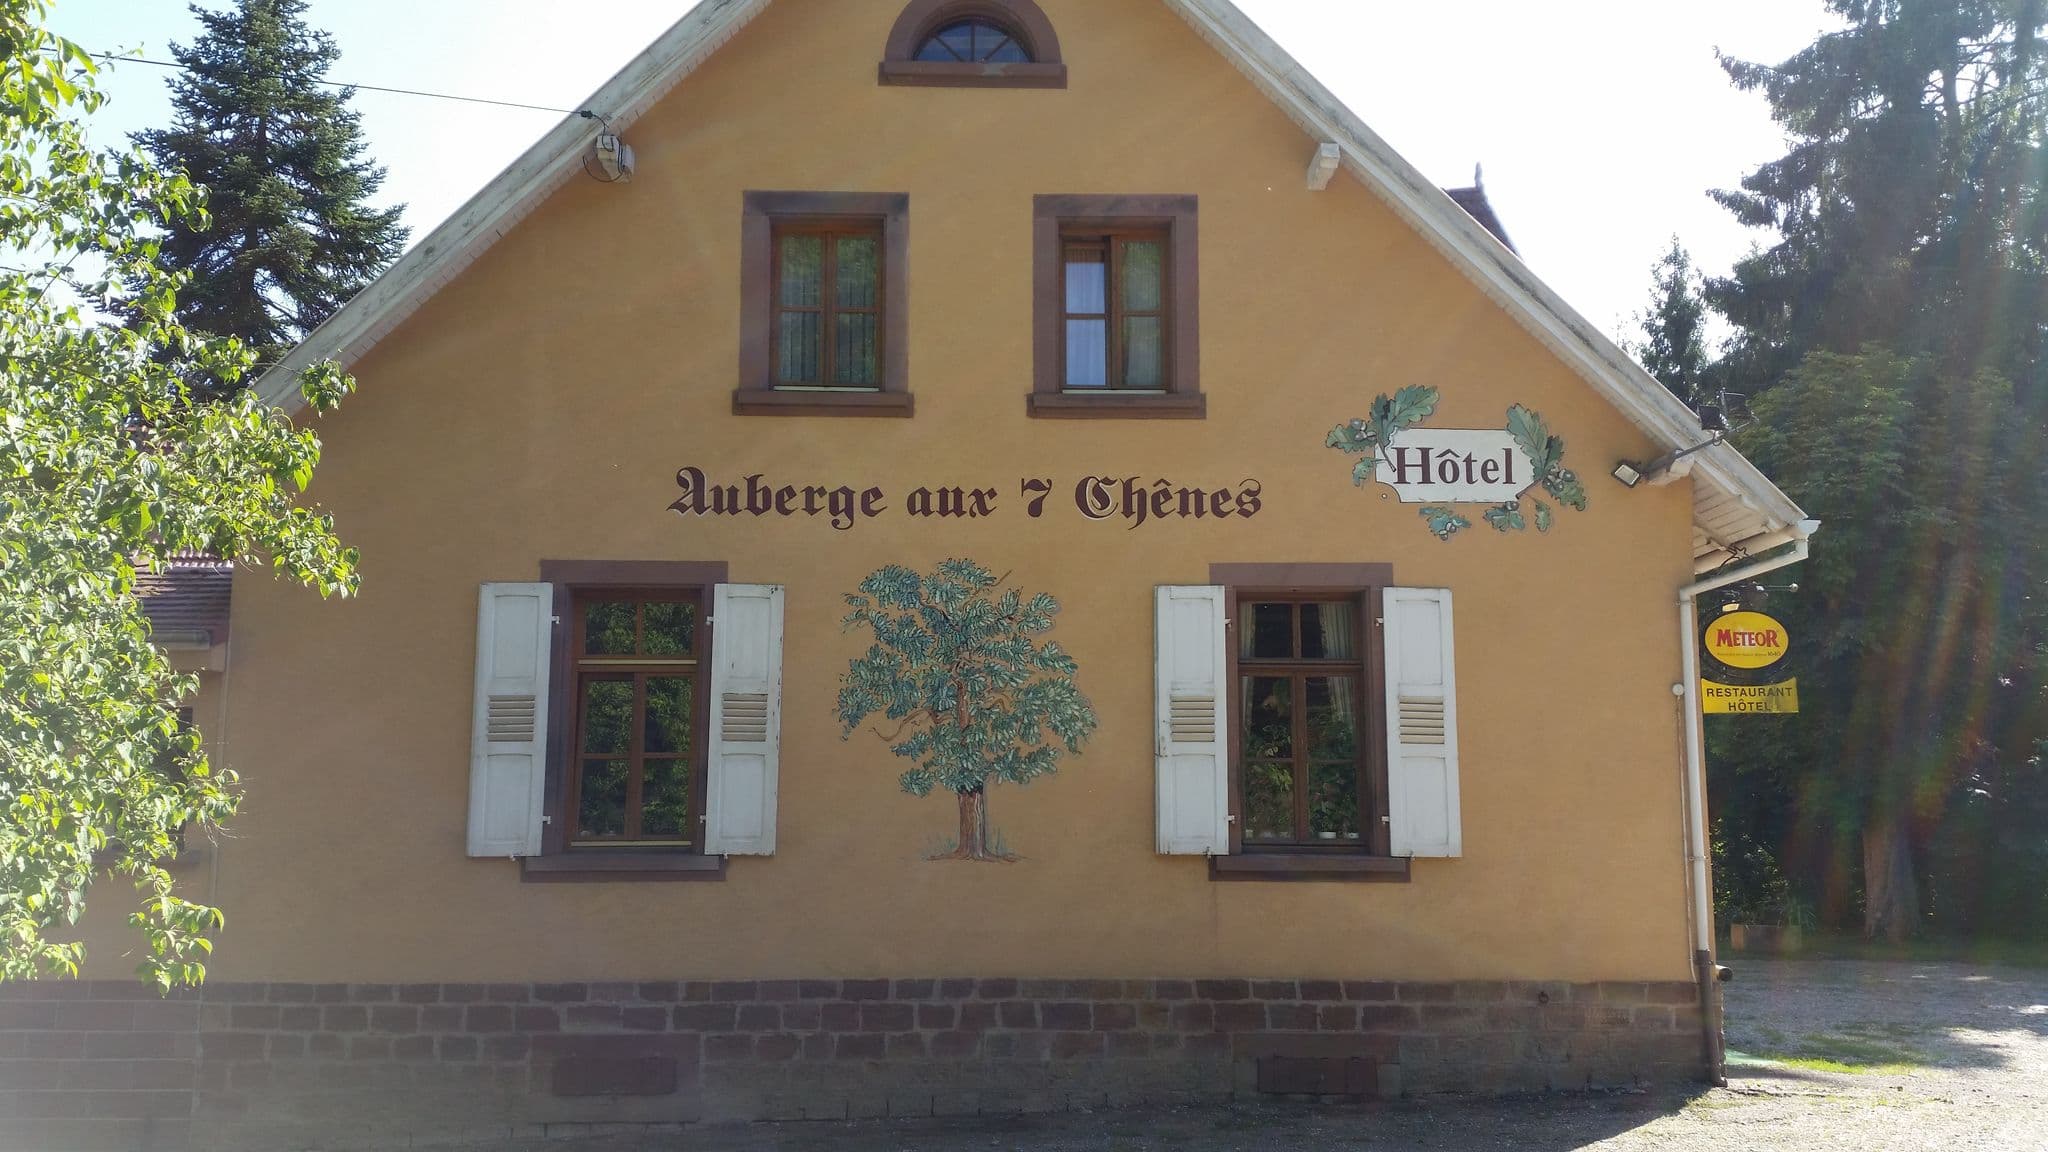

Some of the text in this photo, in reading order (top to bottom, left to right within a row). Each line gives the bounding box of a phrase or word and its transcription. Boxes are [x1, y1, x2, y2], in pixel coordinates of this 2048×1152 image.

[1391, 446, 1516, 485] Hôtel
[666, 466, 1262, 531] Auberge aux 7 Chênes
[1716, 629, 1780, 647] METEOR
[1706, 687, 1792, 698] RESTAURANT
[1728, 698, 1771, 712] HÔTEL
